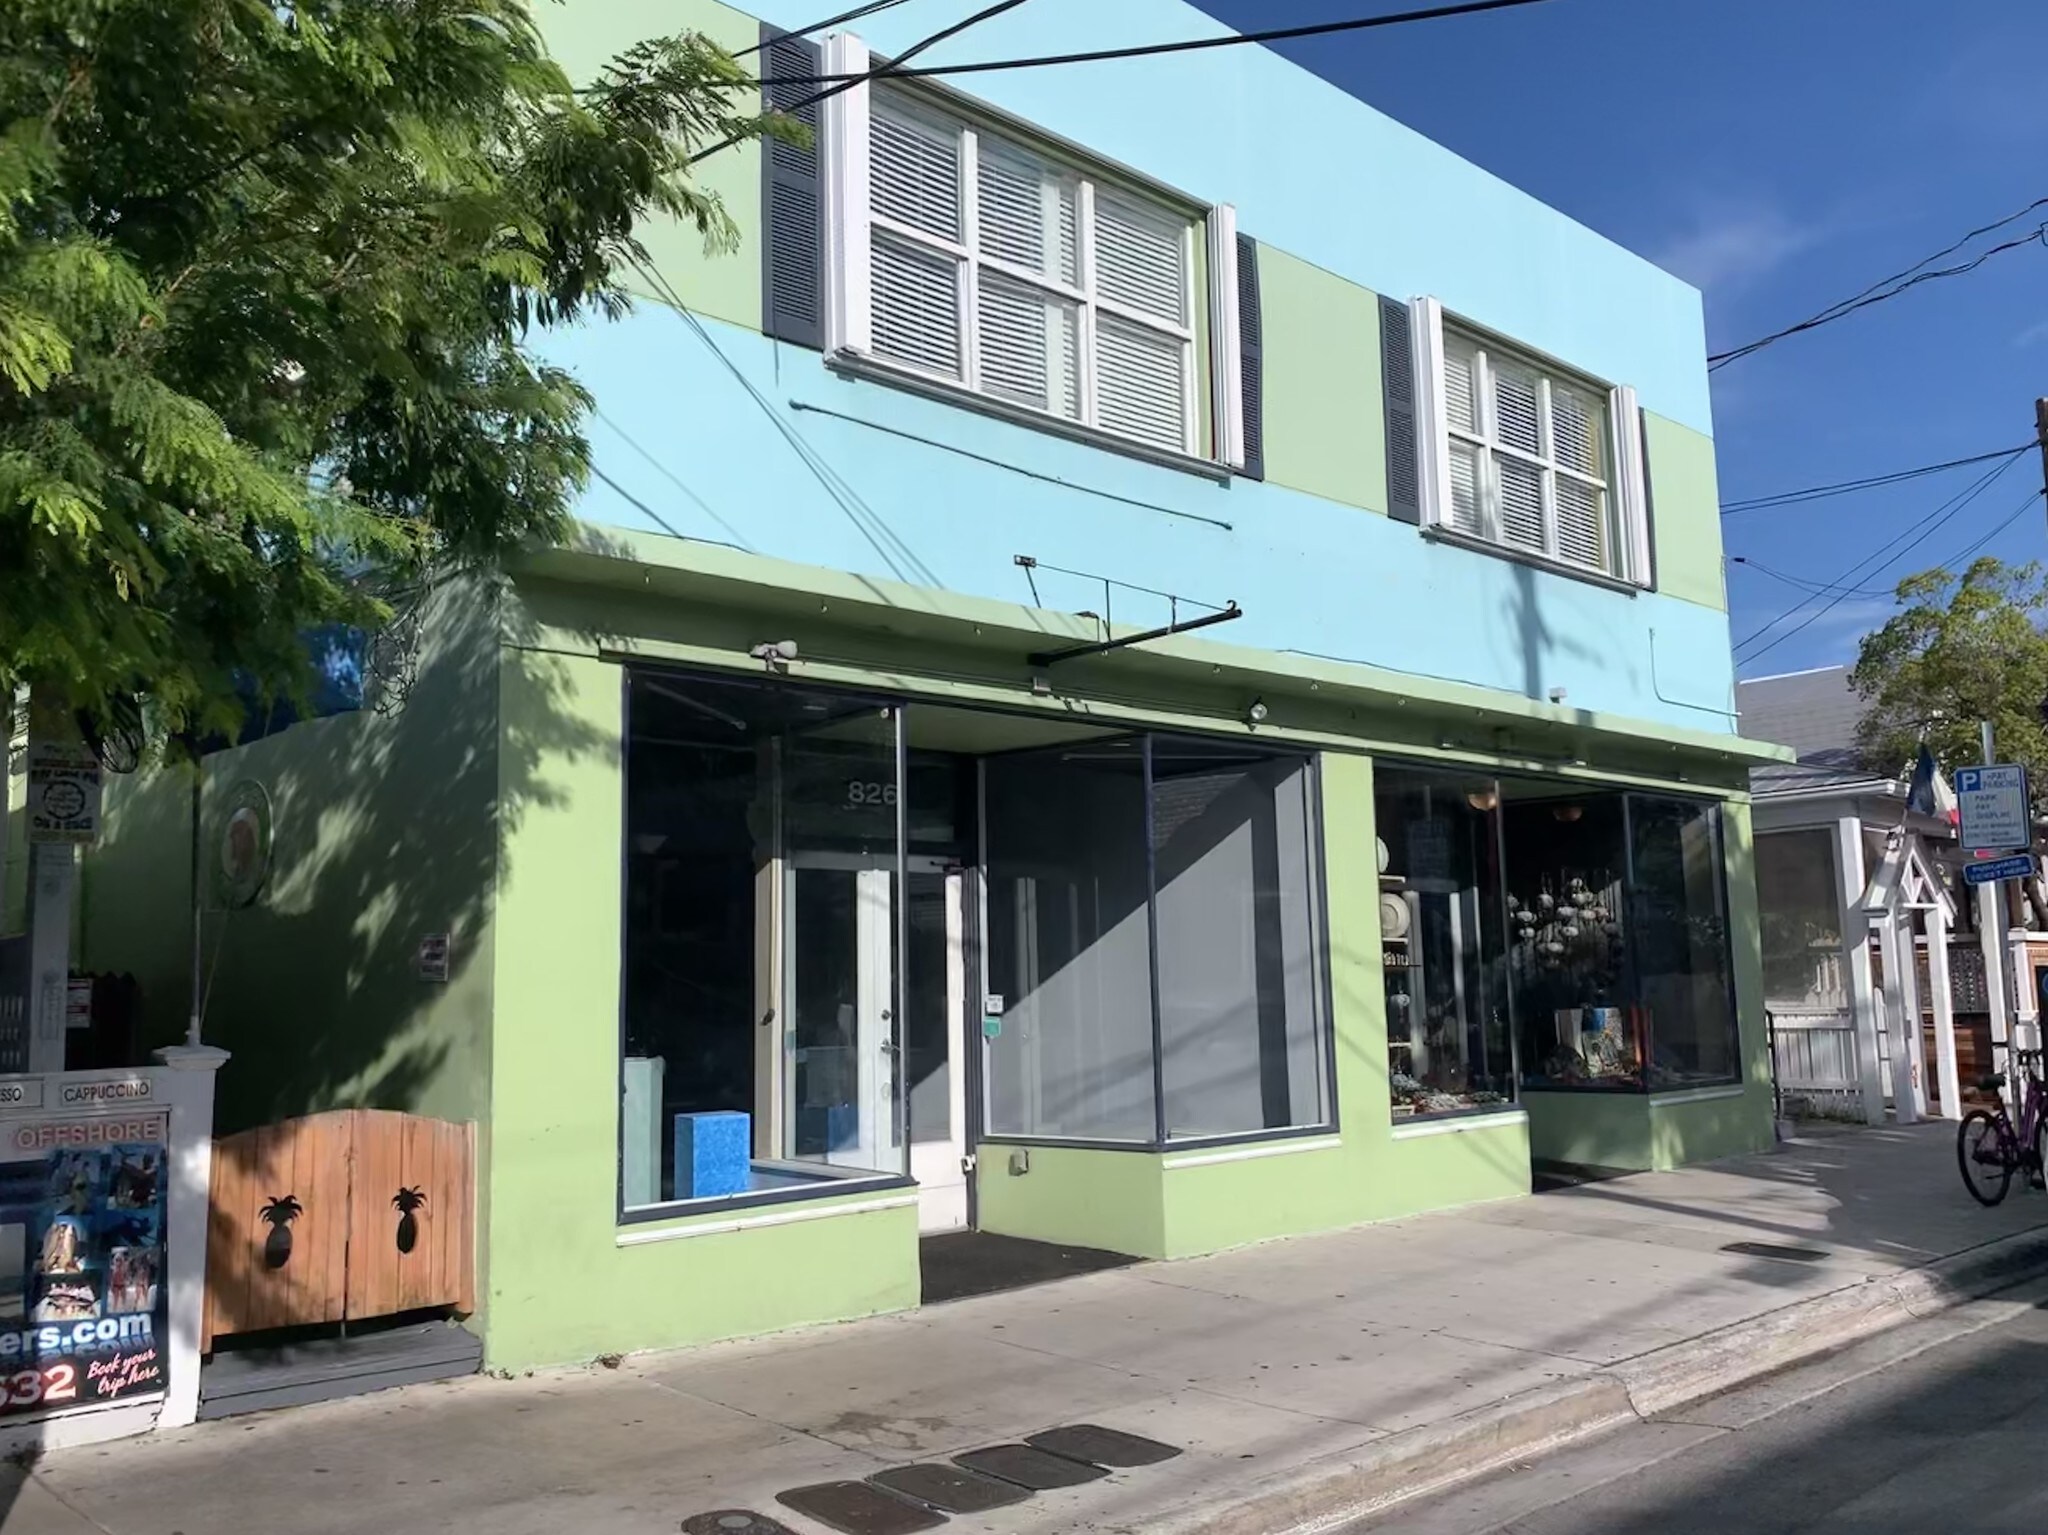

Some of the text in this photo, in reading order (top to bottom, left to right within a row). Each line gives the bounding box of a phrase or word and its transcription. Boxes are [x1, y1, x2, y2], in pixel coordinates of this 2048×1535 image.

[848, 781, 897, 805] 826
[1961, 772, 1978, 791] P
[63, 1082, 150, 1102] CAPPUCCINO
[16, 1119, 160, 1149] OFFSHORE
[87, 1348, 156, 1379] Book your
[0, 1363, 77, 1406] 32
[97, 1363, 160, 1398] trip here
